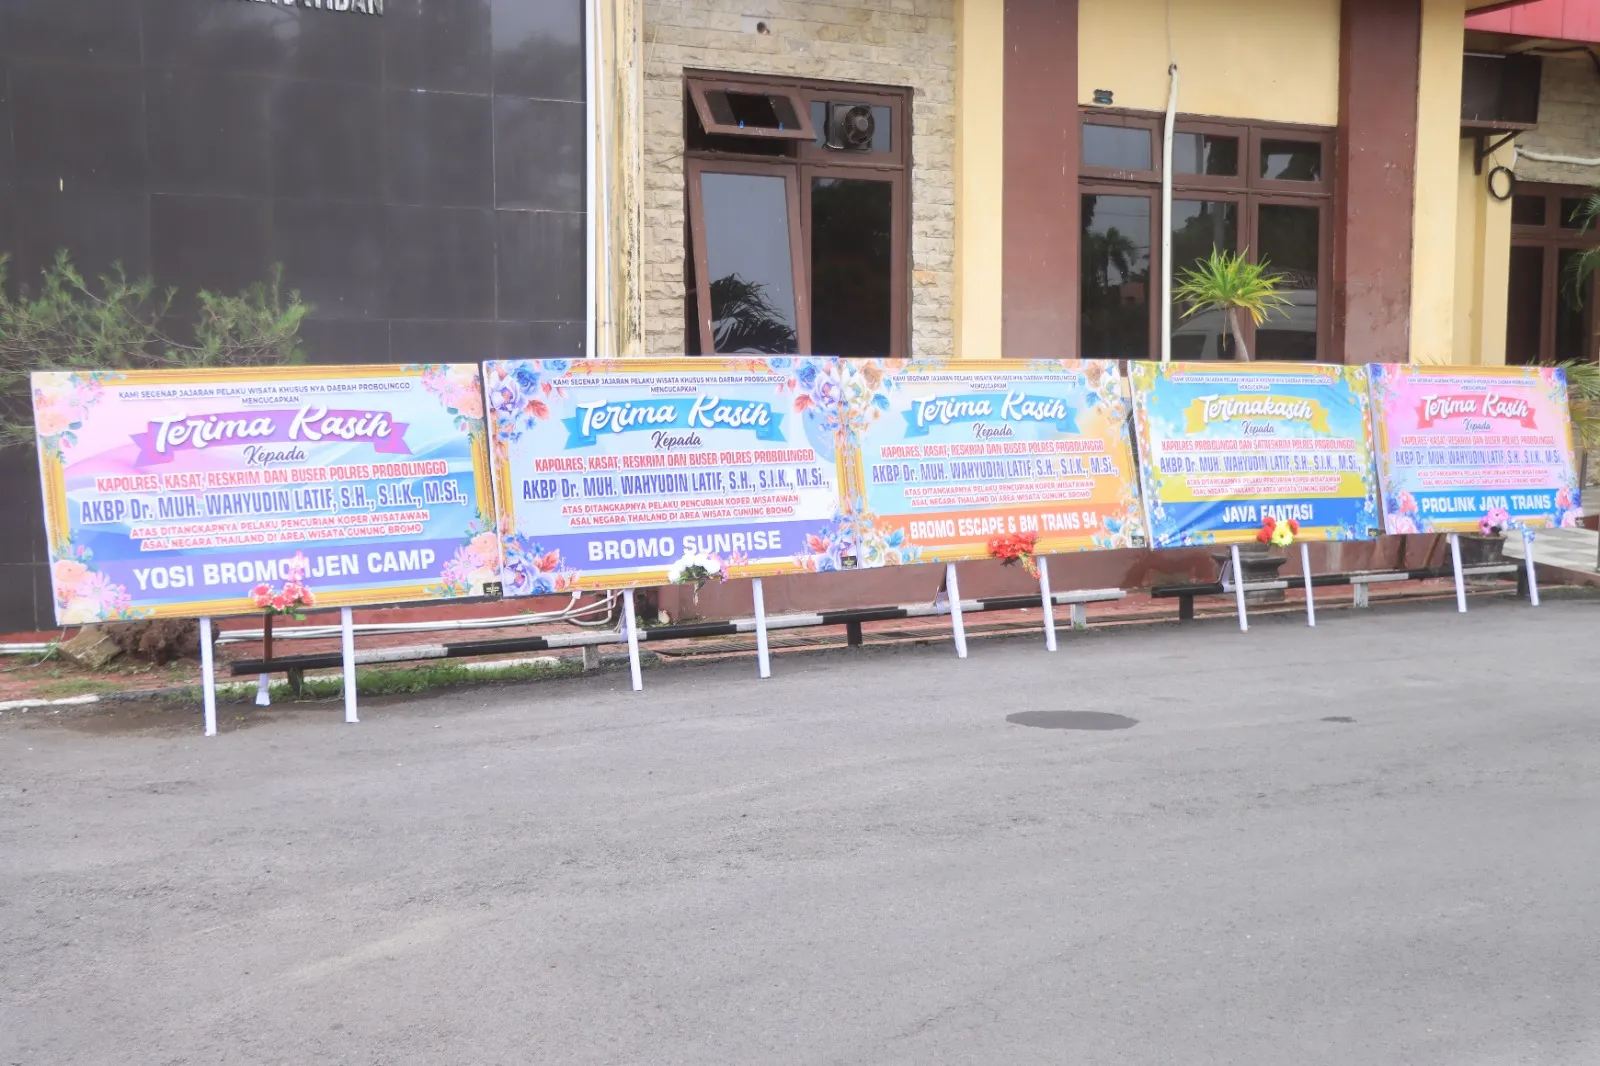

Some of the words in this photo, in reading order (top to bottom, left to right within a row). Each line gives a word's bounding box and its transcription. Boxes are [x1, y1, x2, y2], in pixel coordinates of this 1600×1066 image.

[578, 397, 677, 437] Terima
[686, 391, 770, 428] Kasih
[914, 392, 994, 426] Terima
[999, 389, 1067, 420] Kasih
[1197, 394, 1313, 423] Terimakasih
[1422, 393, 1477, 420] Terima
[1480, 392, 1528, 417] Kasih
[151, 409, 275, 453] Terima
[285, 402, 392, 442] Kasih
[651, 429, 701, 450] Kepada
[972, 421, 1014, 440] Kepada
[242, 443, 308, 466] Kepada
[951, 443, 984, 455] RESKRIM
[986, 443, 1002, 454] DAN
[1004, 442, 1027, 453] BUSER
[1028, 441, 1054, 453] POLRES
[1055, 440, 1104, 452] PROBOLINGGO
[535, 458, 586, 475] KAPOLRES,
[589, 457, 621, 473] KASAT,
[623, 455, 664, 468] RESKRIM
[667, 454, 686, 466] DAN
[689, 452, 717, 465] BUSER
[720, 451, 751, 464] POLRES
[754, 448, 813, 463] PROBOLINGGO
[871, 464, 900, 482] AKBP
[902, 464, 917, 481] Dr.
[920, 462, 947, 480] MUH.
[950, 460, 1004, 479] WAHYUDIN
[1159, 456, 1183, 472] AKBP
[1223, 456, 1268, 472] WAHYUDIN
[96, 475, 162, 494] KAPOLRES,
[164, 473, 205, 490] KASAT,
[207, 470, 260, 485] RESKRIM
[263, 469, 287, 483] DAN
[291, 467, 326, 481] BUSER
[329, 465, 369, 479] POLRES
[372, 461, 446, 477] PROBOLINGGO
[521, 479, 557, 500] AKBP
[560, 478, 578, 498] Dr.
[583, 476, 616, 497] MUH.
[620, 473, 687, 495] WAHYUDIN
[691, 471, 725, 493] LATIF,
[728, 469, 755, 491] S.H.,
[758, 467, 793, 490] S.I.K.,
[80, 499, 125, 521] AKBP
[130, 498, 152, 519] Dr.
[158, 495, 200, 517] MUH.
[205, 490, 290, 514] WAHYUDIN
[295, 488, 337, 512] LATIF,
[340, 485, 374, 509] S.H.,
[378, 483, 421, 507] S.I.K.,
[561, 505, 582, 514] ATAS
[648, 500, 678, 509] PELAKU
[681, 497, 723, 507] PENCURIAN
[725, 495, 750, 505] KOPER
[751, 493, 798, 503] WISATAWAN
[1222, 506, 1256, 523] JAVA
[1421, 496, 1475, 512] PROLINK
[1478, 495, 1507, 510] JAYA
[1511, 494, 1551, 509] TRANS
[131, 527, 157, 537] ATAS
[241, 520, 277, 530] PELAKU
[281, 517, 334, 528] PENCURIAN
[337, 515, 368, 524] KOPER
[369, 512, 428, 522] WISATAWAN
[570, 517, 590, 526] ASAL
[628, 512, 667, 523] THAILAND
[670, 512, 678, 520] DI
[680, 511, 700, 520] AREA
[702, 509, 732, 518] WISATA
[767, 505, 793, 514] BROMO
[909, 519, 954, 539] BROMO
[957, 516, 1004, 536] ESCAPE
[1007, 516, 1015, 533] &
[1018, 514, 1038, 532] BM
[1040, 512, 1078, 531] TRANS
[1082, 511, 1097, 528] 94
[142, 538, 167, 549] ASAL
[215, 533, 264, 544] THAILAND
[267, 532, 277, 541] DI
[279, 530, 304, 540] AREA
[307, 528, 345, 538] WISATA
[388, 523, 421, 533] BROMO
[587, 536, 675, 562] BROMO
[682, 528, 781, 554] SUNRISE
[132, 565, 194, 590] YOSI
[366, 548, 436, 573] CAMP
